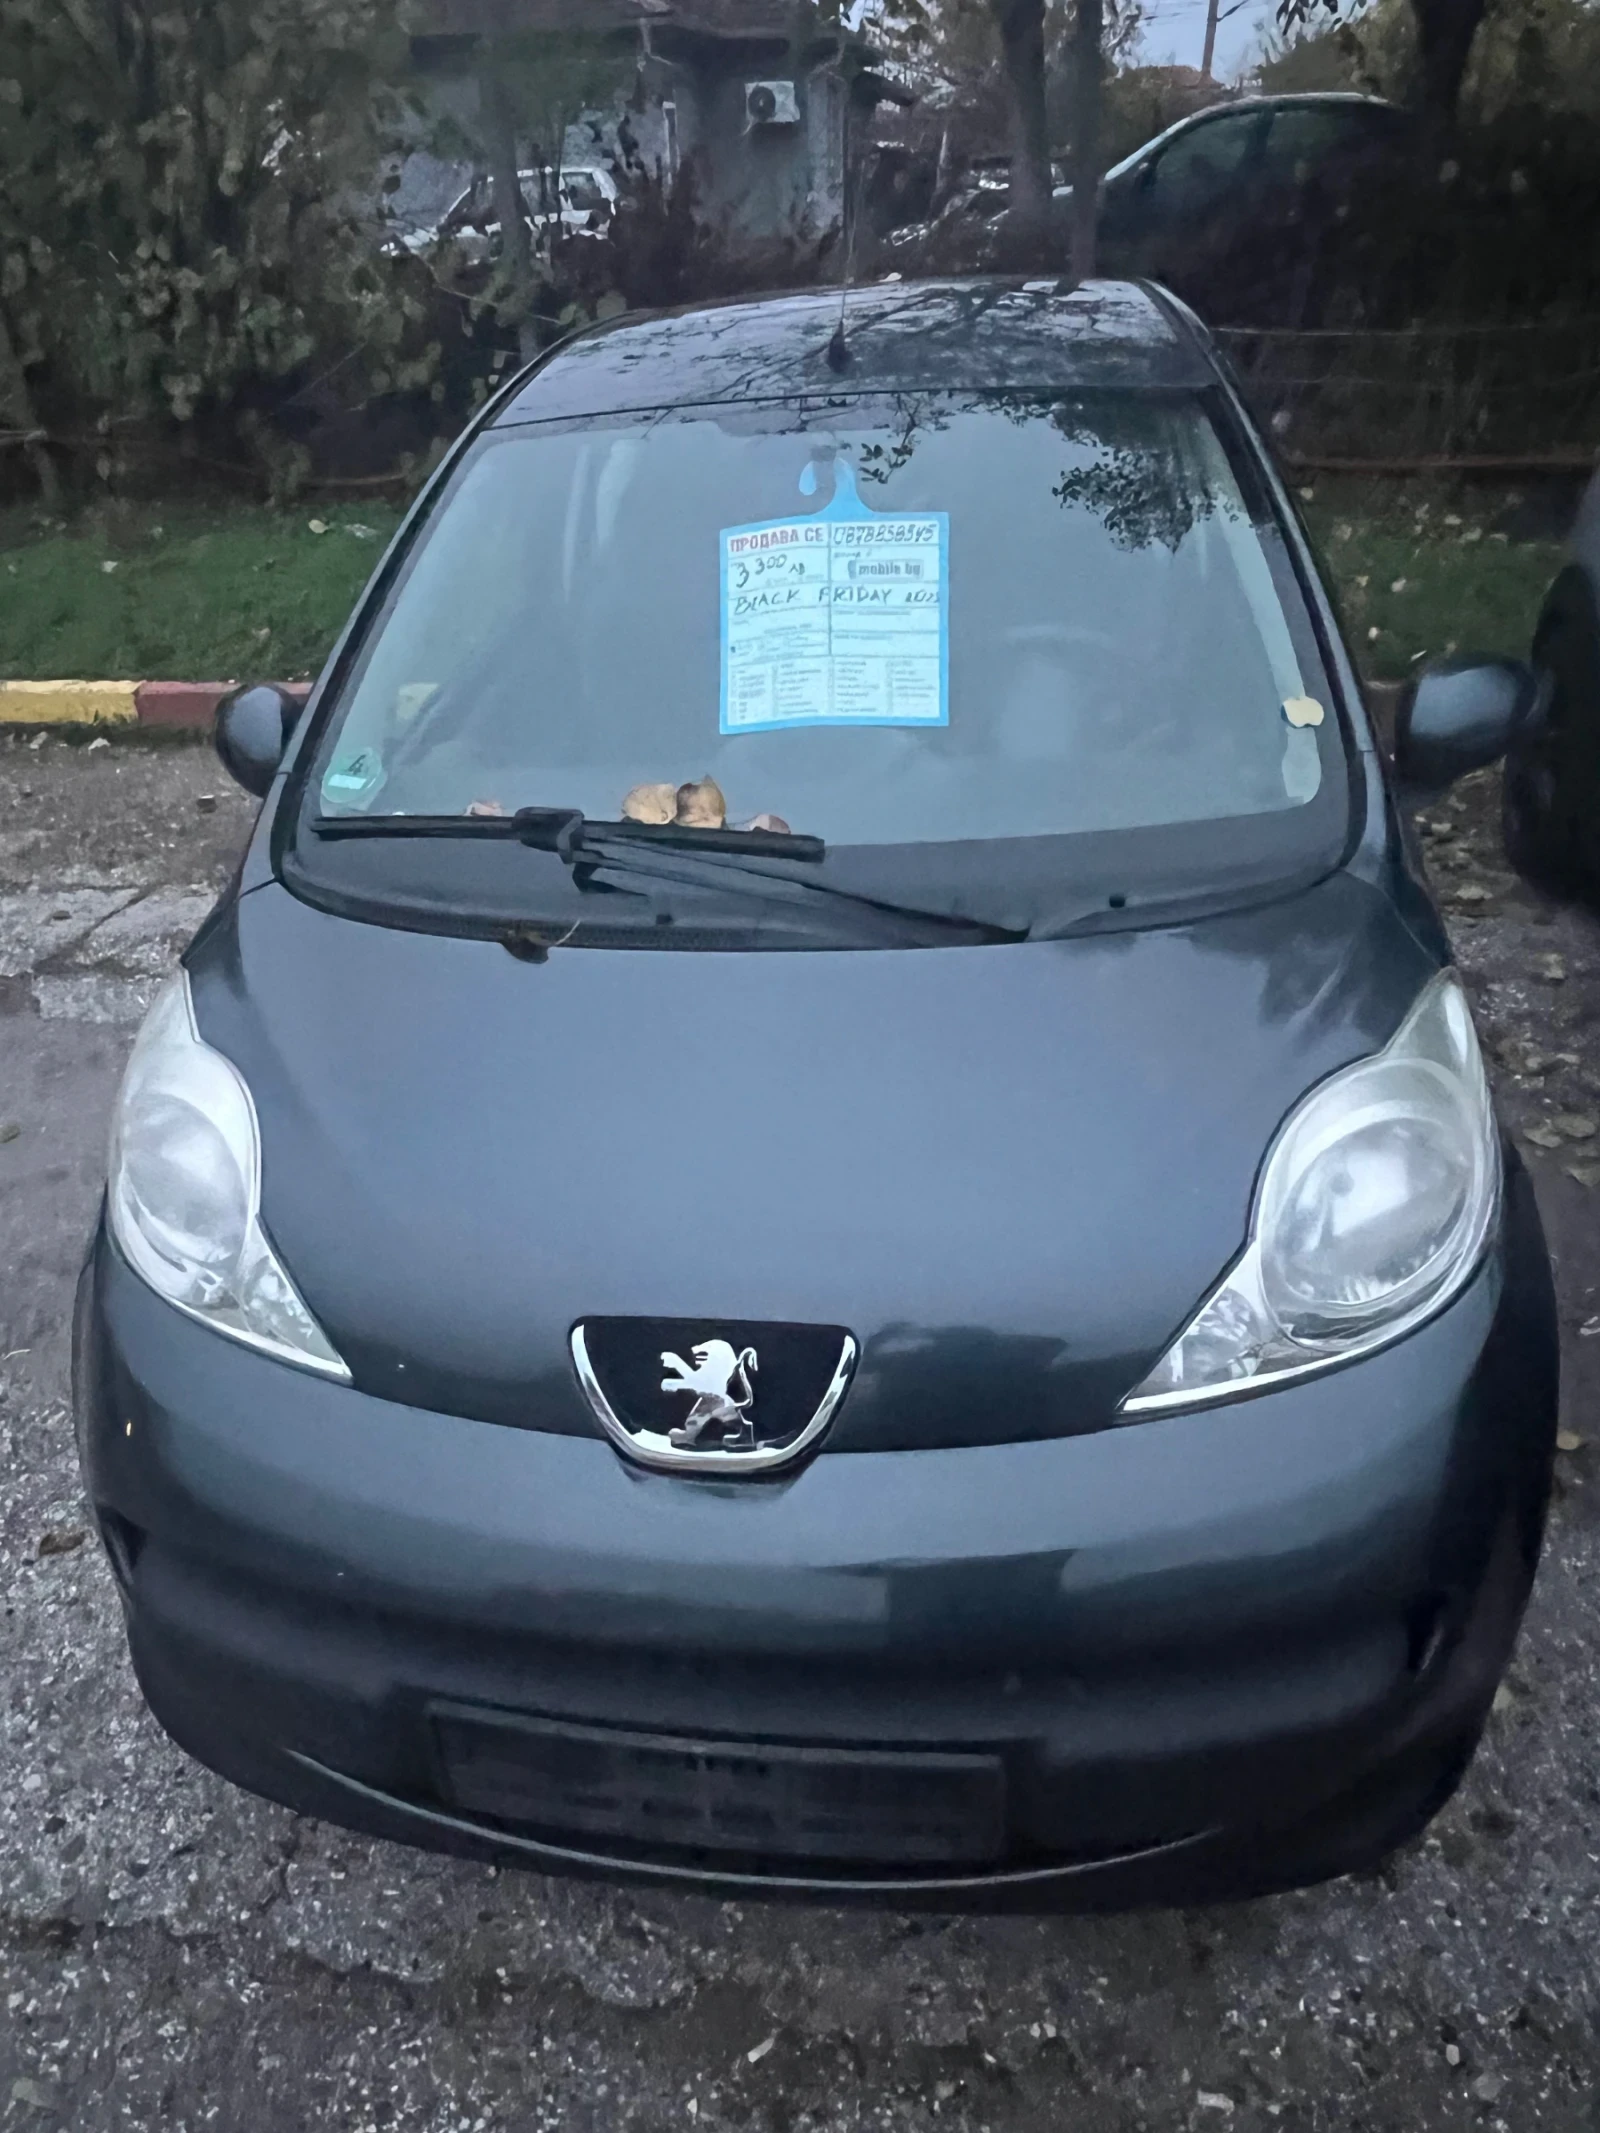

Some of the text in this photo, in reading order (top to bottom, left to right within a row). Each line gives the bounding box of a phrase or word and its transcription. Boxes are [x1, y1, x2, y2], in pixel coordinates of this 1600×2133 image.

[730, 526, 824, 553] ПРОДАВА СЕ
[734, 589, 800, 615] BLACK
[818, 586, 893, 606] FRIDAY
